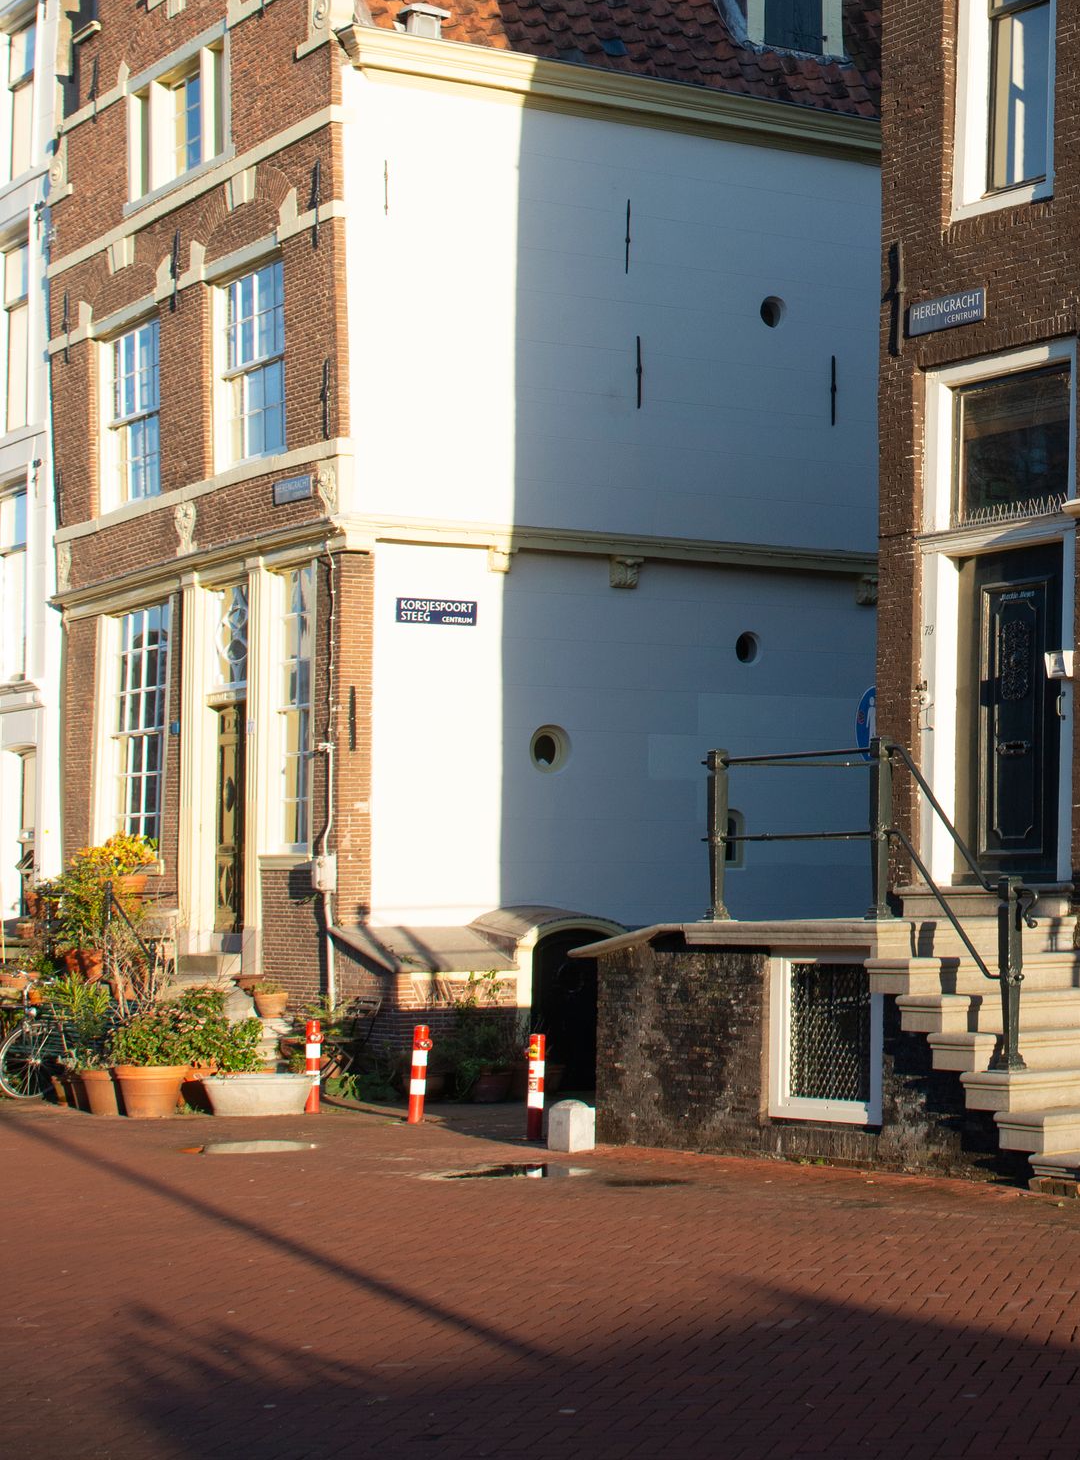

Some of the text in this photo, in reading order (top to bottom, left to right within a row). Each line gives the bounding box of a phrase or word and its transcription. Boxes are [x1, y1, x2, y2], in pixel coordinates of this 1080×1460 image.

[913, 292, 981, 320] HERENGRACHT
[400, 600, 474, 613] KORSJESPOORT
[400, 611, 473, 624] STEEG CENTRUM
